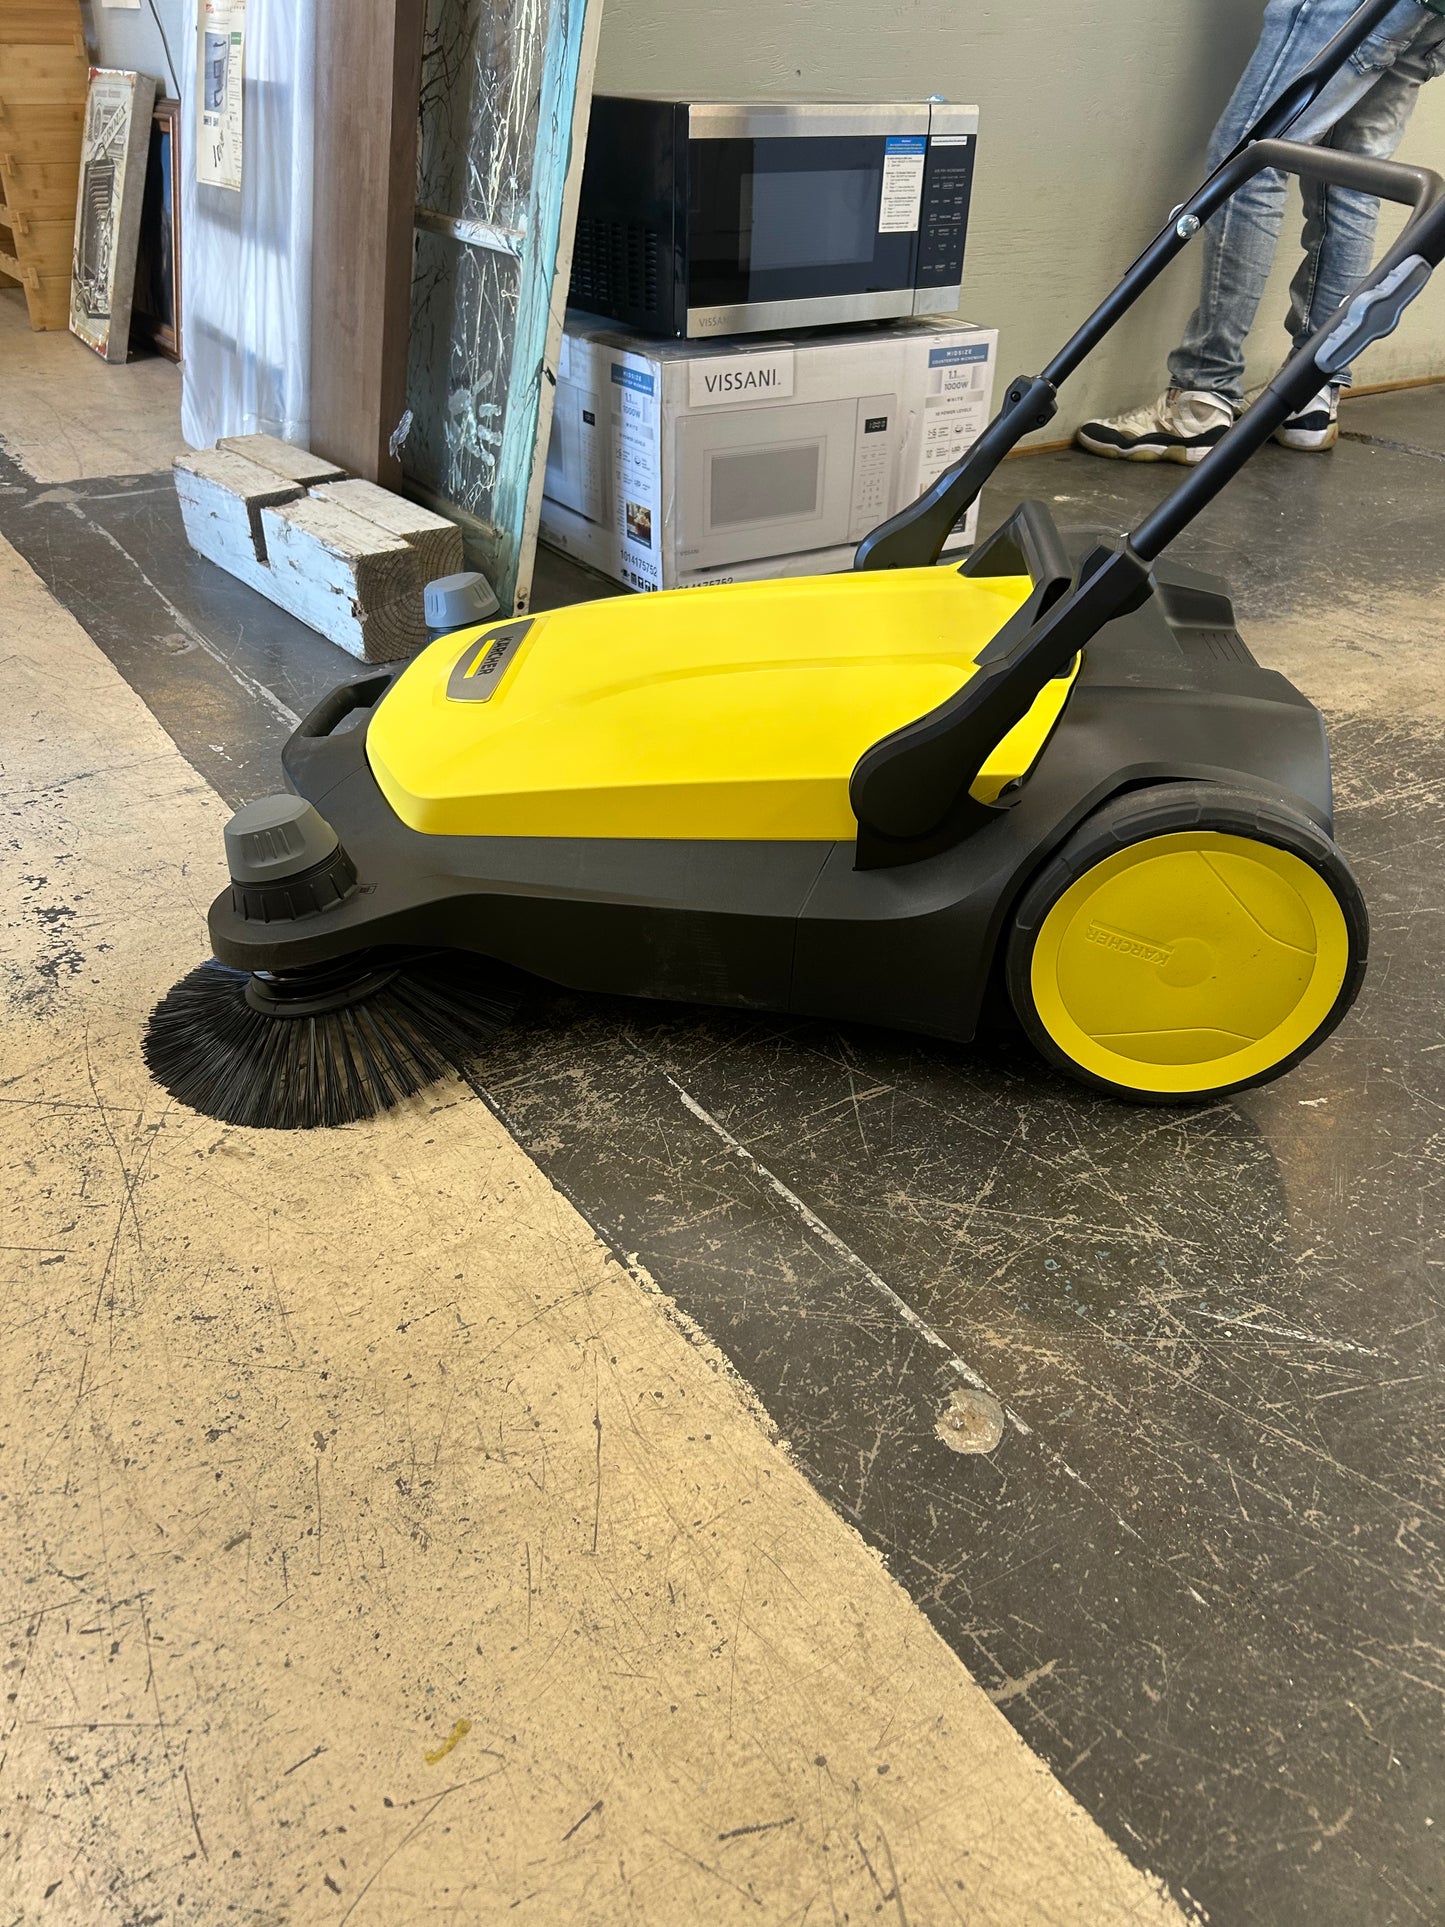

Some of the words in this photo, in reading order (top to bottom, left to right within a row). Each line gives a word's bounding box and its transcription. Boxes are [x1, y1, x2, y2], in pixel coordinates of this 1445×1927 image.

[946, 348, 973, 357] MIDSIZE
[944, 381, 969, 391] 1000W
[620, 549, 658, 578] 1014175752
